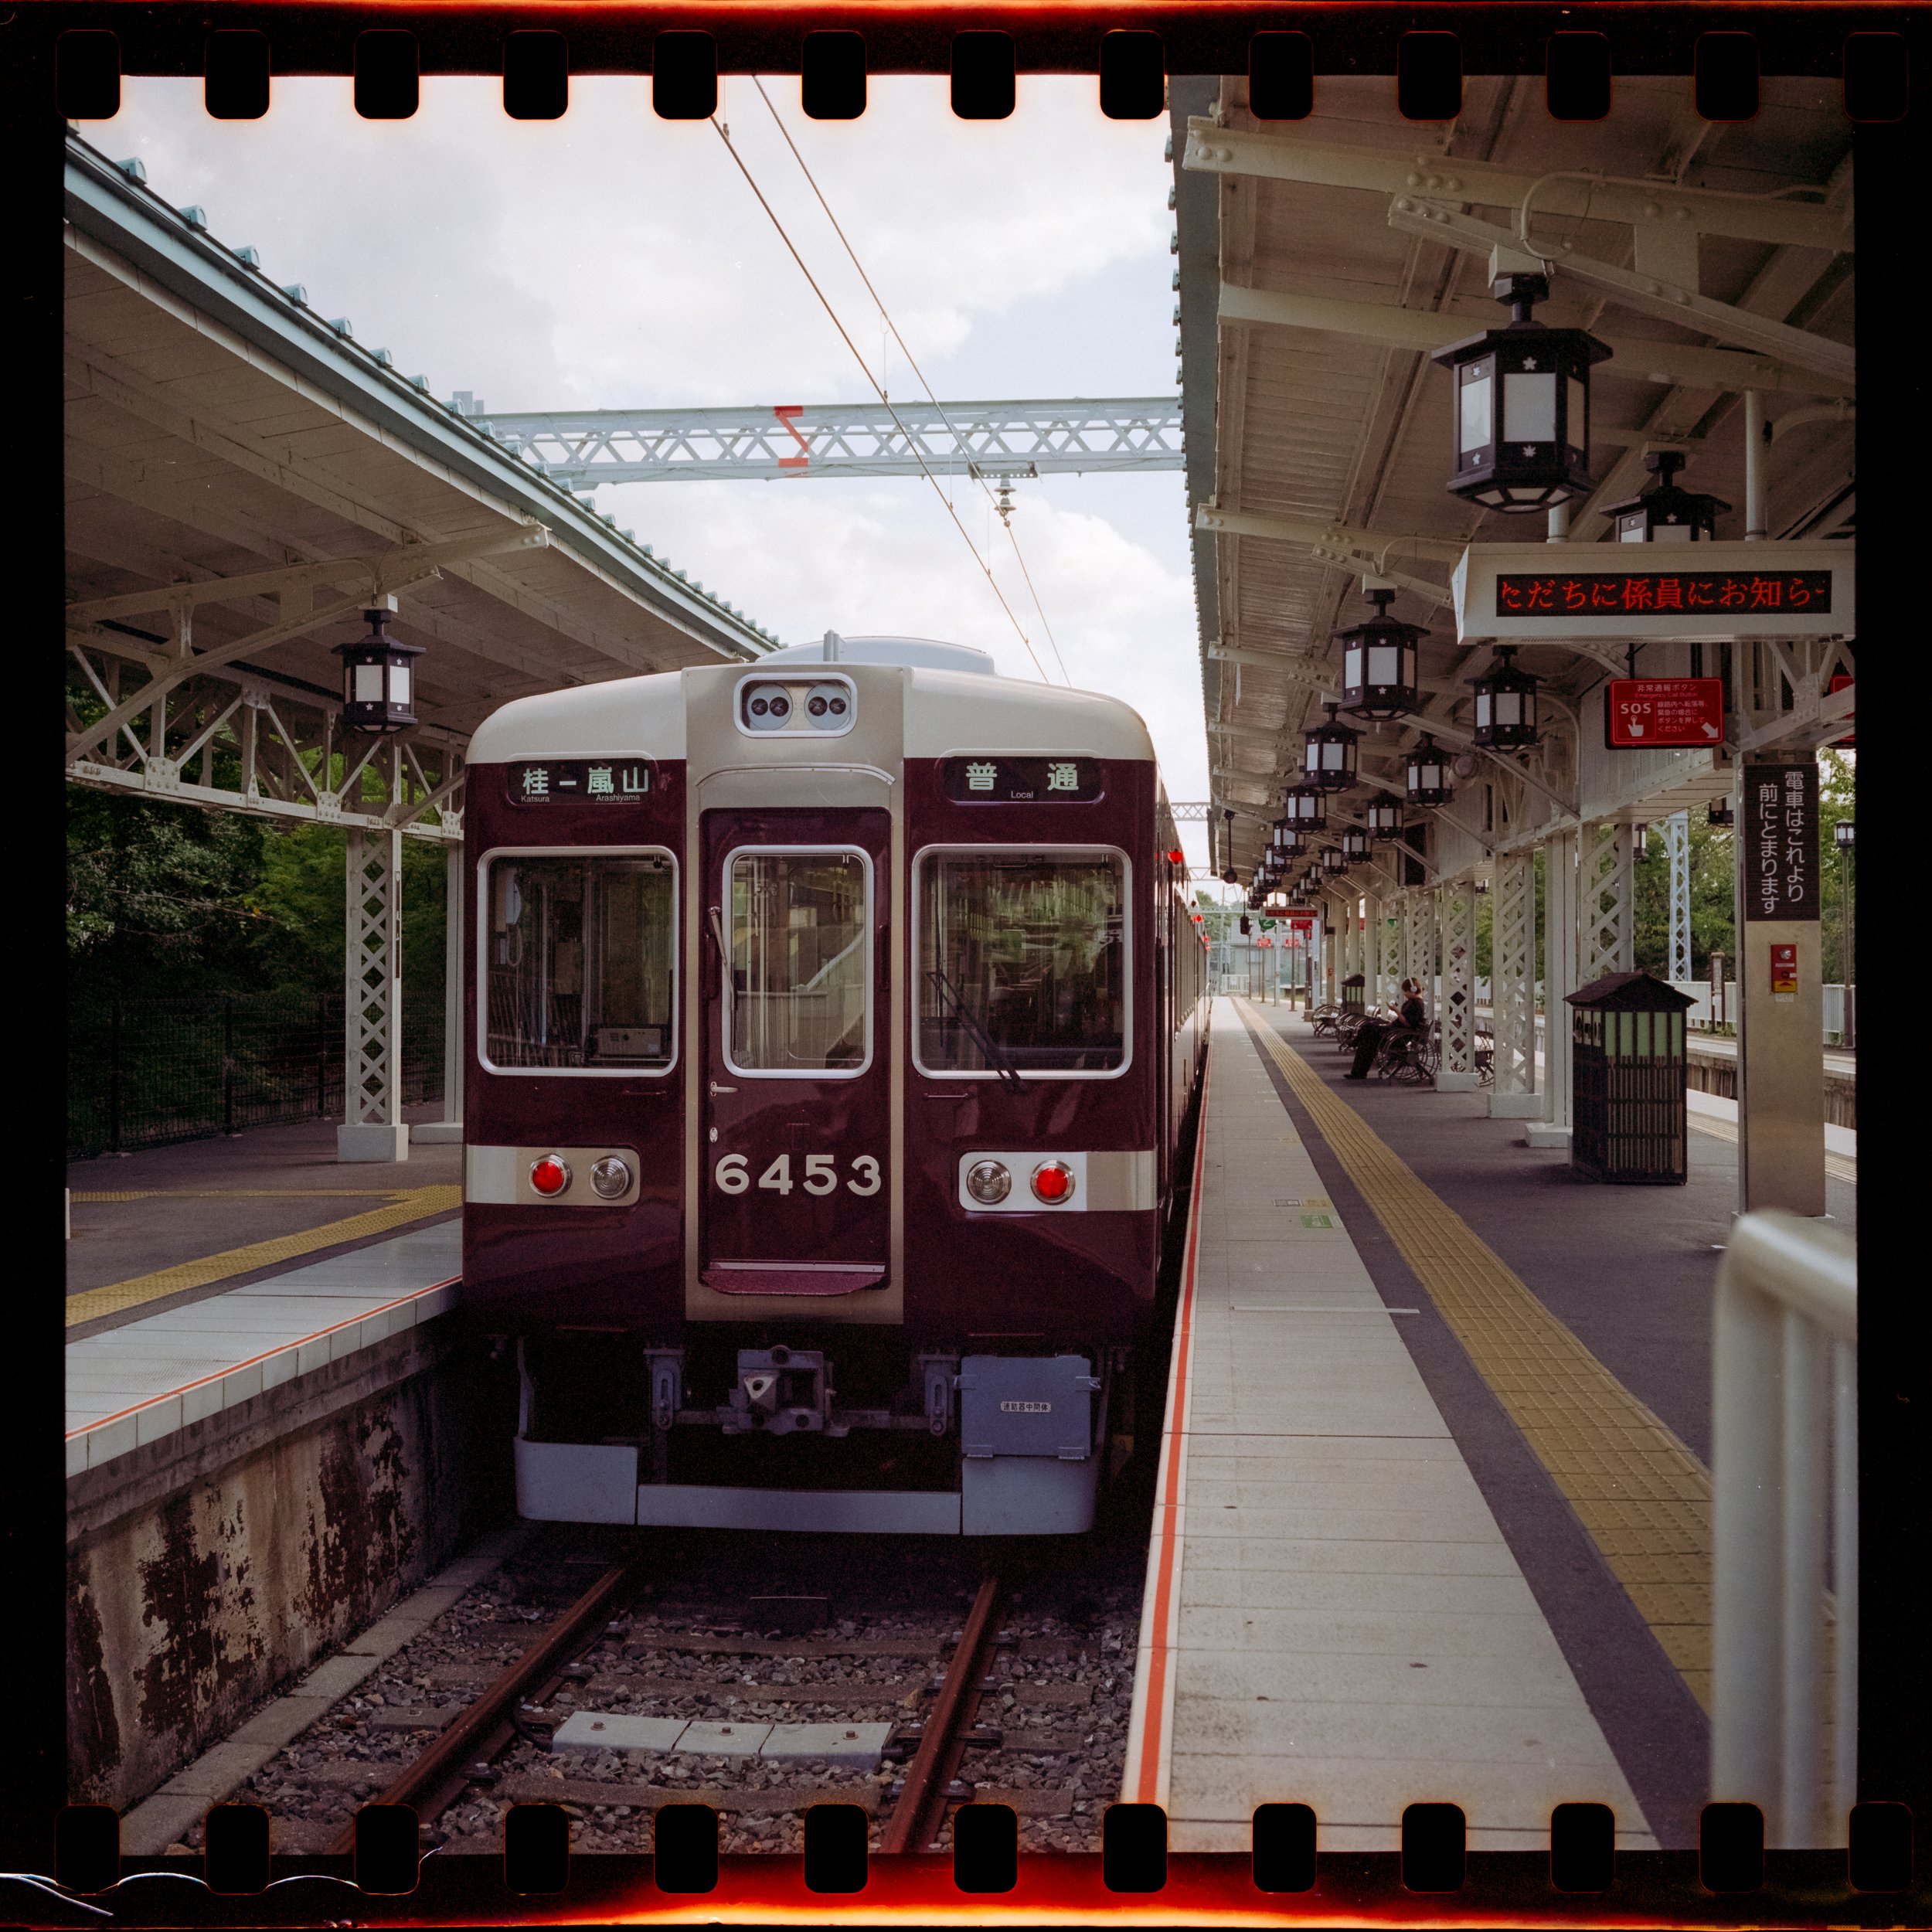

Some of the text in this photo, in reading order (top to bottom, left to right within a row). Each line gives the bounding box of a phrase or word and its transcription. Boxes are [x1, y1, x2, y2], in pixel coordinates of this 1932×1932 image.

[1502, 577, 1825, 609] ただちに係員にお知ら
[1621, 702, 1651, 714] SOS
[596, 794, 640, 803] Arashiyama
[1759, 783, 1780, 914] 前にとまります
[1784, 771, 1804, 902] 電車はこれより
[716, 1154, 881, 1196] 6453
